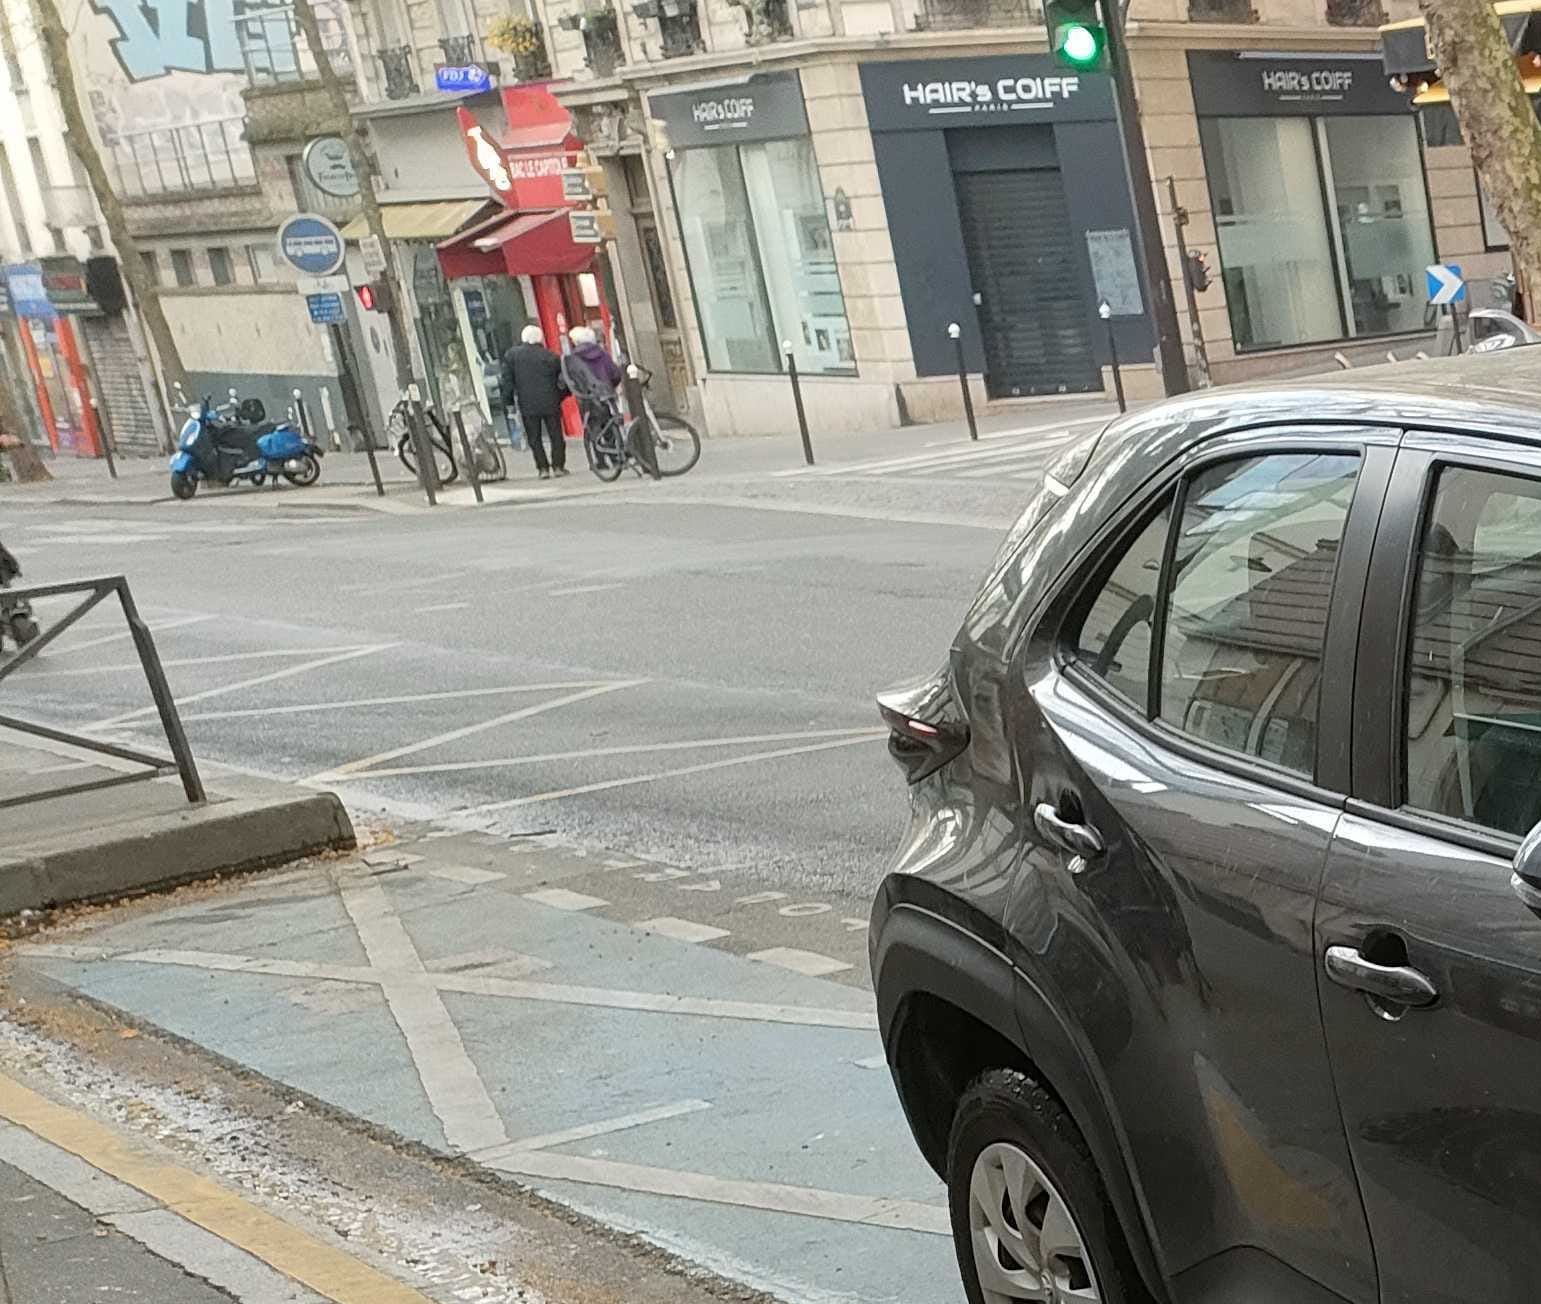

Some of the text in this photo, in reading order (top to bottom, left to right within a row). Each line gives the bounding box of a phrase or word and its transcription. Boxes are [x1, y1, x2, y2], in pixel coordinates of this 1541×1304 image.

[902, 77, 1080, 105] HAIR's COIFF
[1262, 71, 1353, 90] HAIR's COIFF
